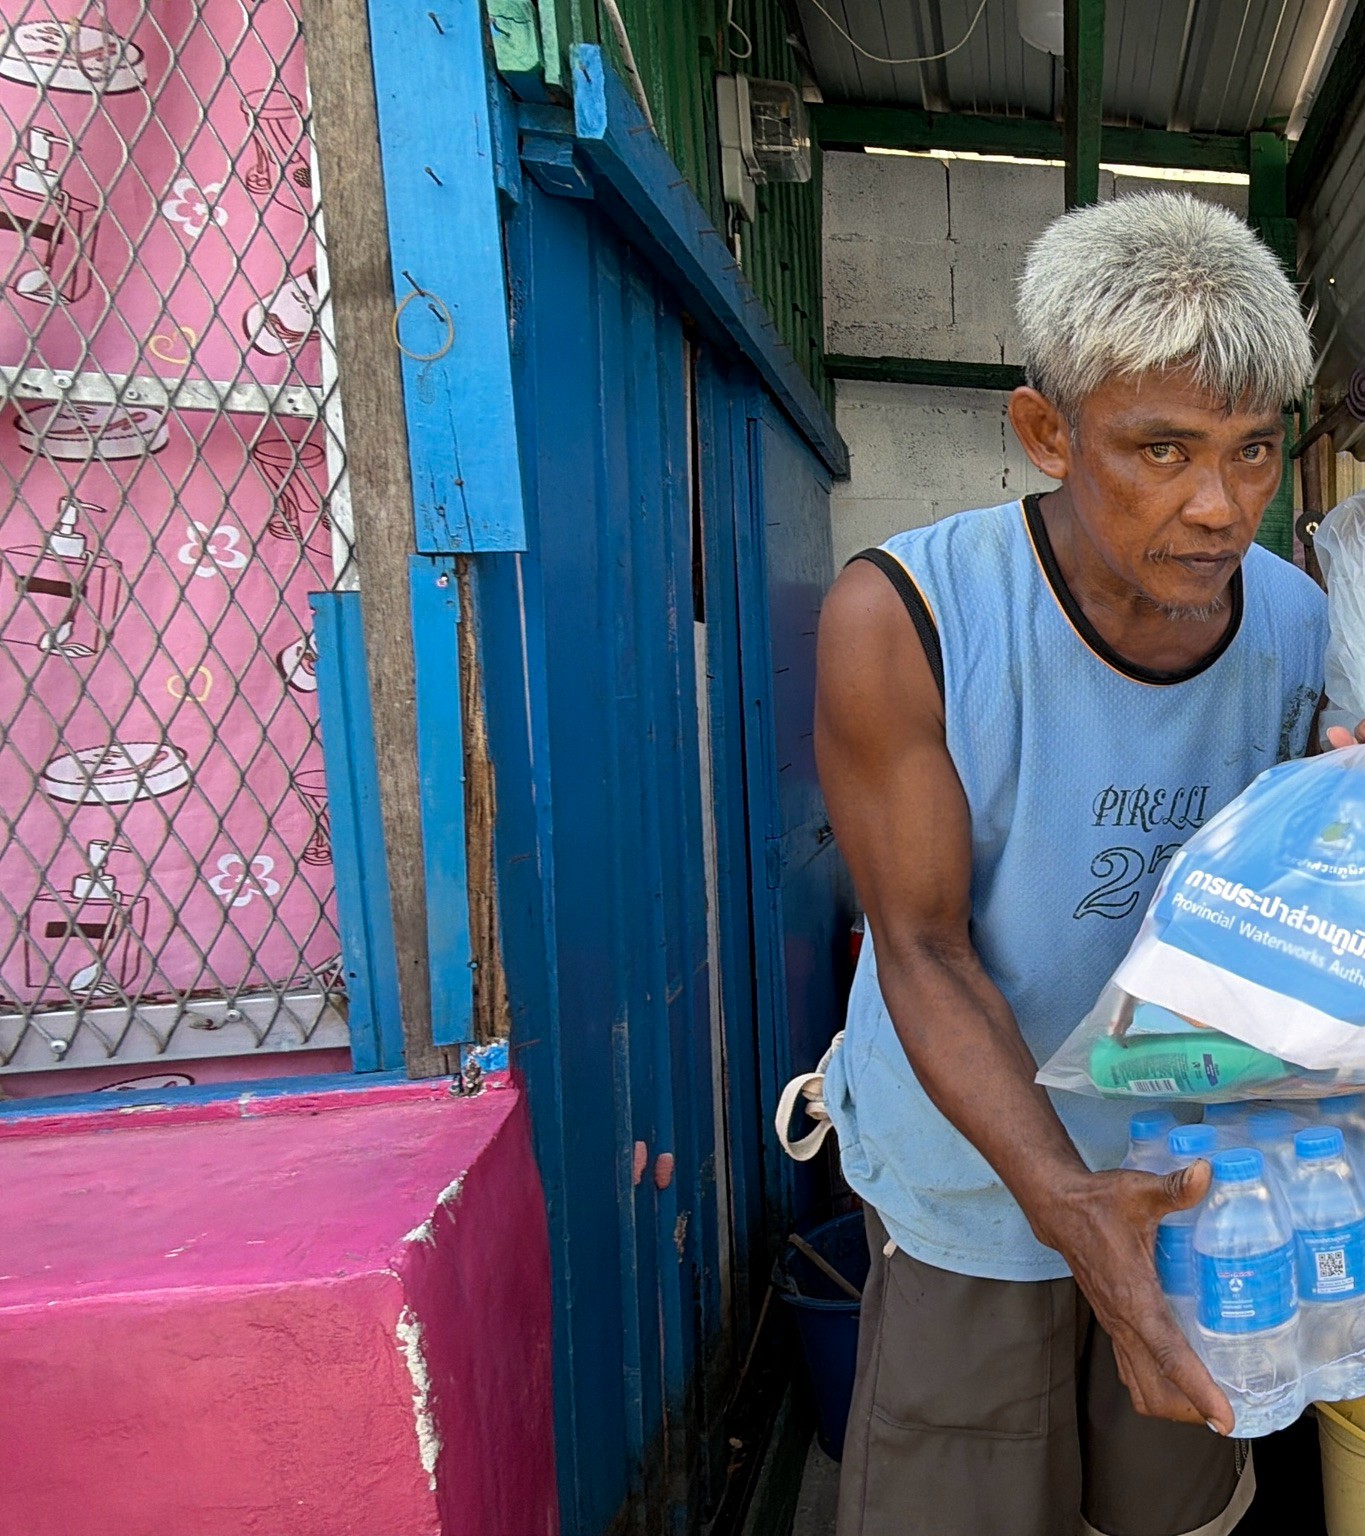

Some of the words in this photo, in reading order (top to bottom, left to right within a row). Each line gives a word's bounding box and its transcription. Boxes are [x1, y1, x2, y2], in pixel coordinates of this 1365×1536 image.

[1091, 783, 1211, 833] PIRELLI
[1172, 892, 1236, 930] Provincial
[1238, 919, 1325, 969] Waterworks
